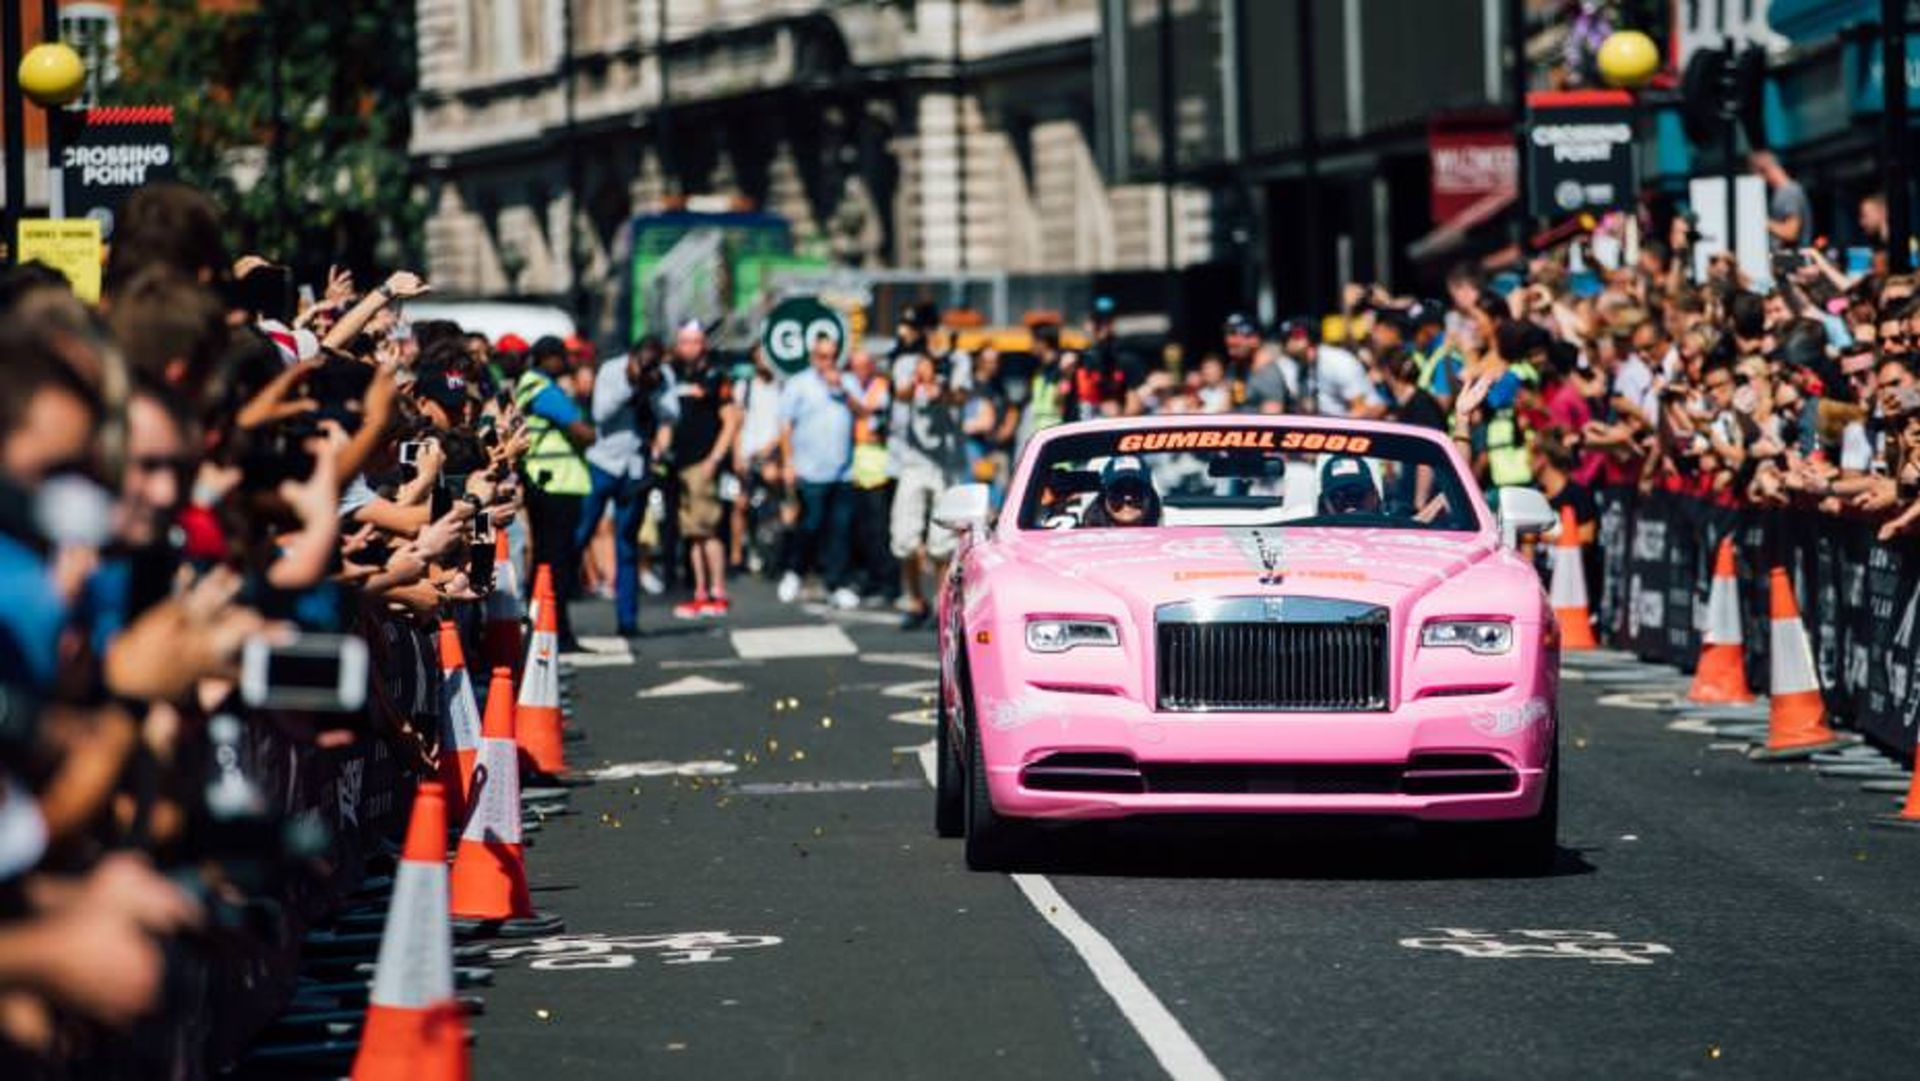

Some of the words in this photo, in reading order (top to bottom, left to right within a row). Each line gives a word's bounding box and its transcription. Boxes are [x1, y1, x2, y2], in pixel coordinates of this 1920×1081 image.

[83, 166, 147, 185] POINT
[770, 319, 839, 361] GO
[1118, 431, 1274, 451] GUMBALL
[1281, 432, 1371, 451] 3000
